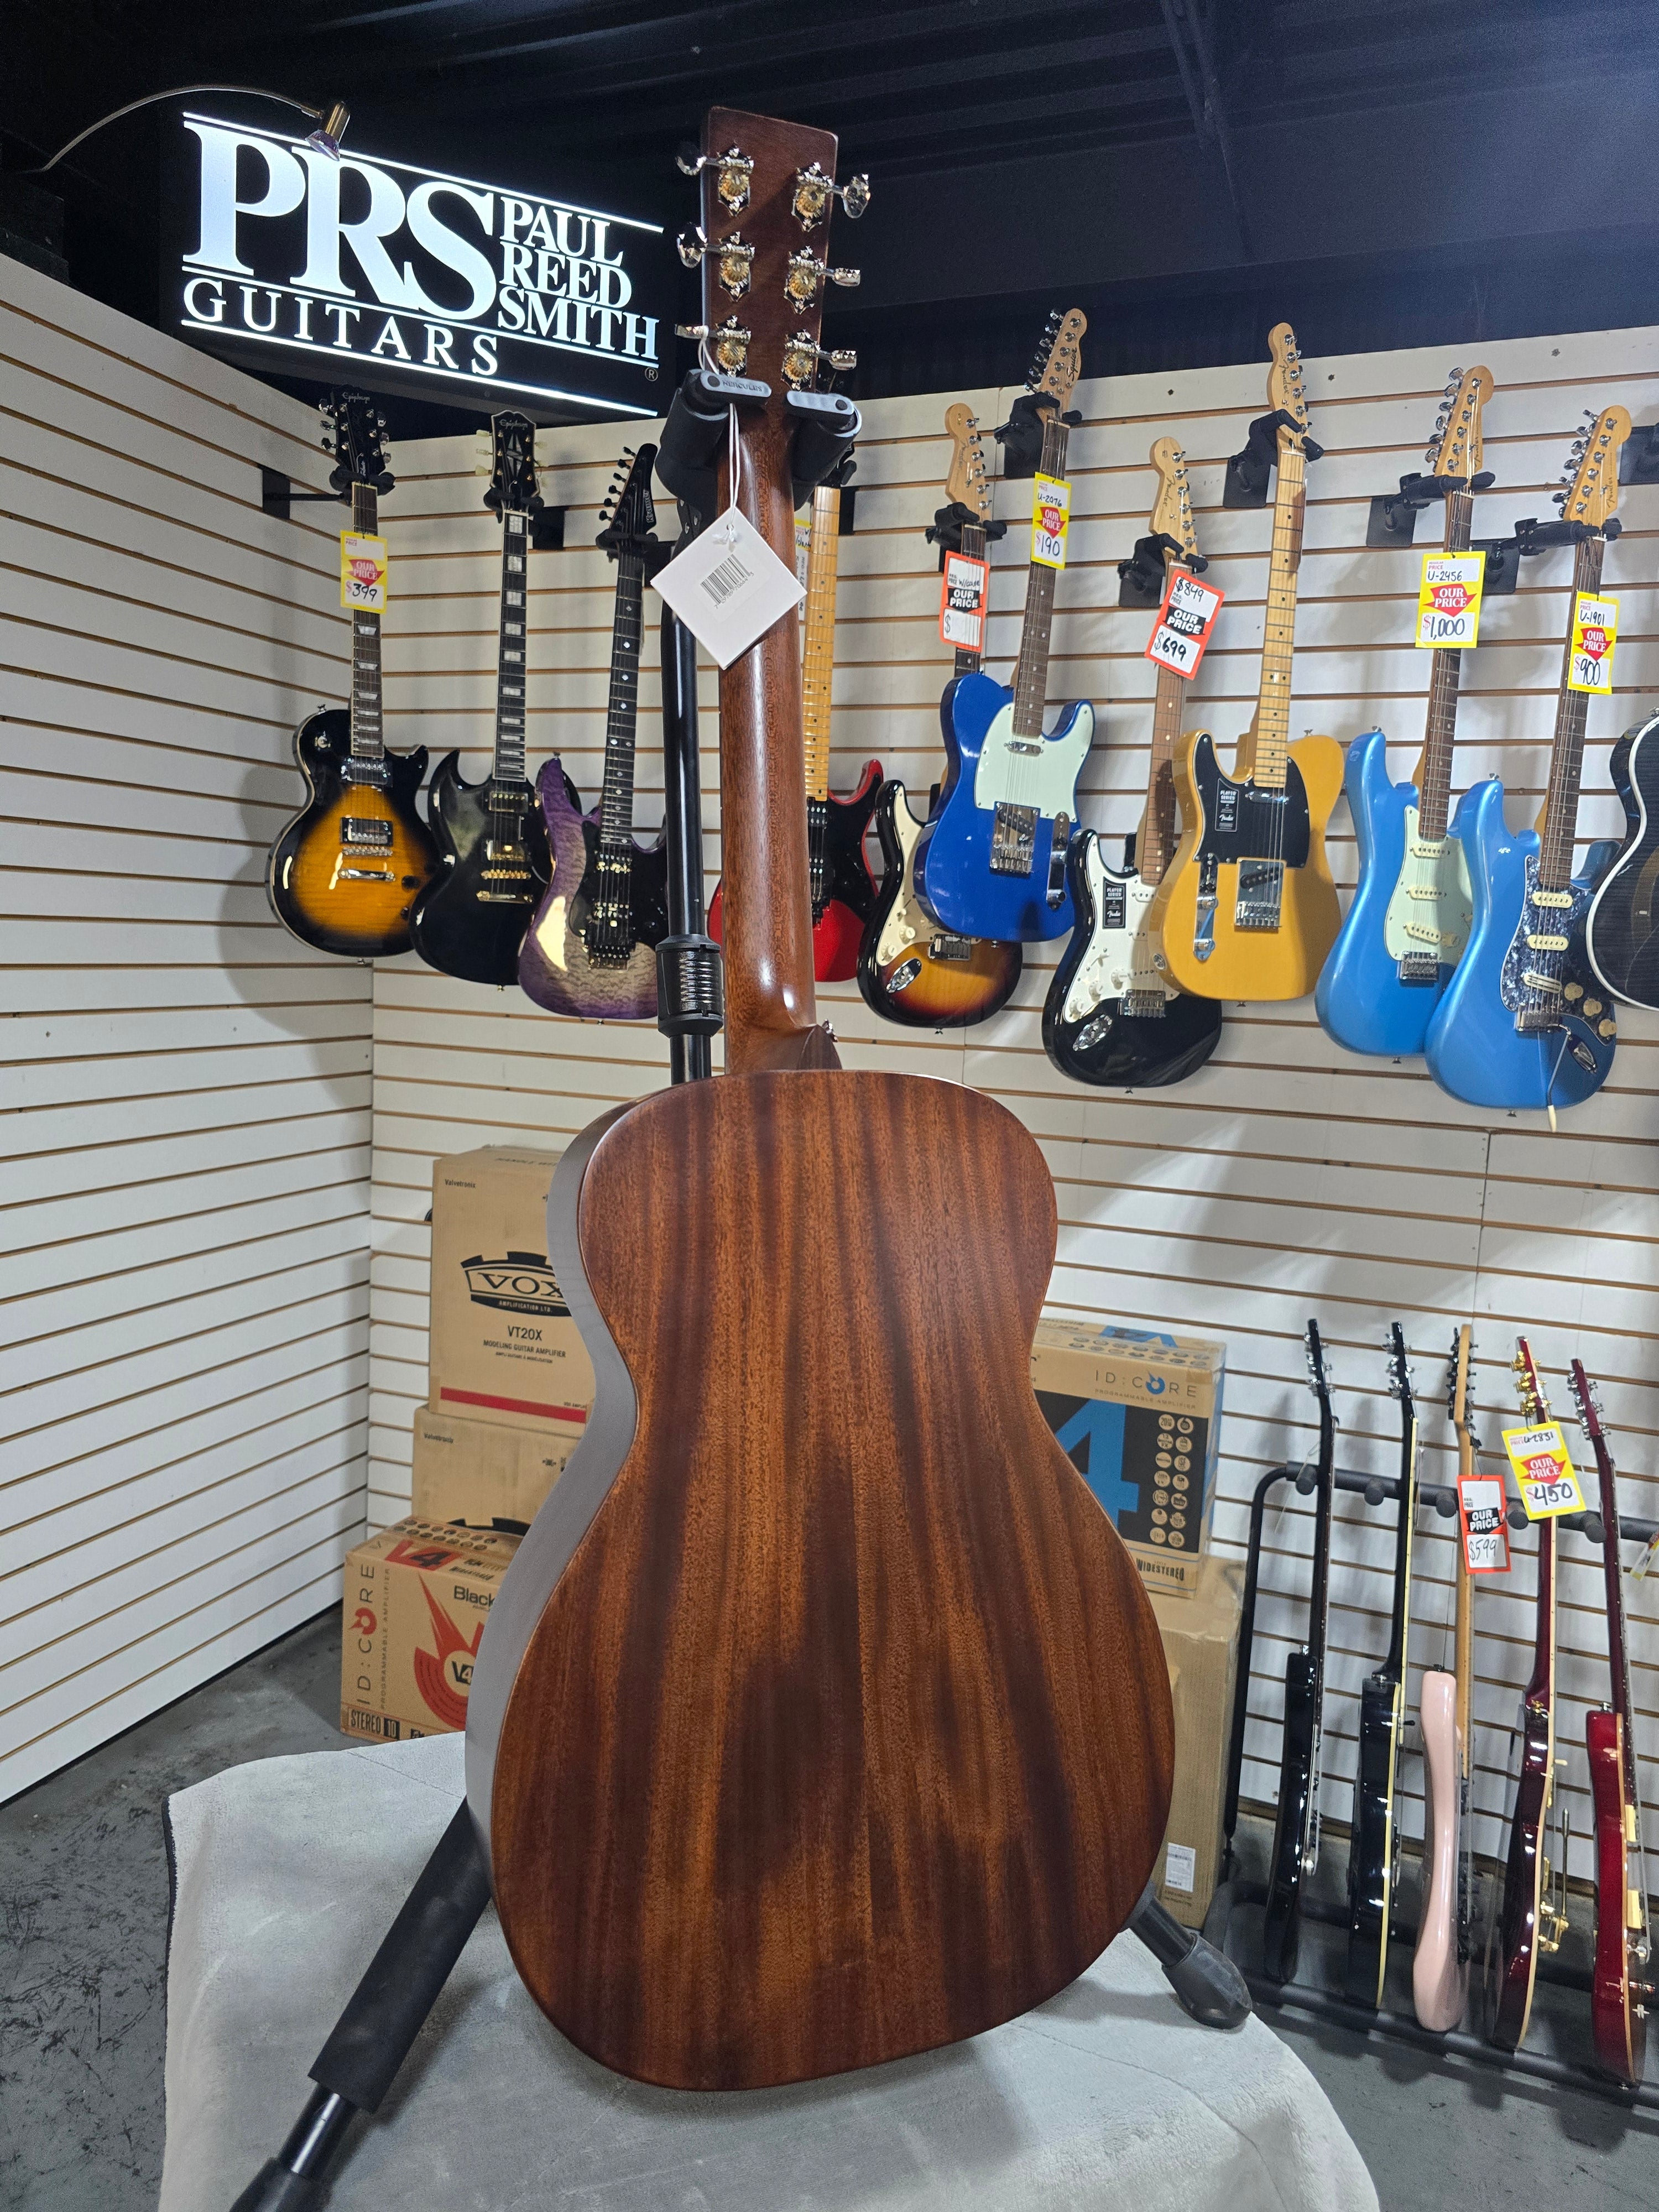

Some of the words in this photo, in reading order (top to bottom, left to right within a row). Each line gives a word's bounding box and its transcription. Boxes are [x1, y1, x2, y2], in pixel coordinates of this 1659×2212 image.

[184, 121, 497, 320] PRS
[499, 196, 624, 267] PAUL
[499, 241, 632, 309] REED
[183, 278, 498, 376] GUITARS
[498, 287, 660, 361] SMITH
[1066, 347, 1078, 382] Squier
[722, 380, 763, 392] HERCULES
[1279, 359, 1291, 394] Fender
[1163, 475, 1175, 507] Fender
[1605, 477, 1615, 508] Fender
[643, 489, 654, 523] Kramer
[1045, 509, 1059, 521] OUR
[1042, 518, 1060, 531] PRICE
[1036, 532, 1060, 556] $190
[353, 570, 378, 580] PRICE
[356, 561, 374, 571] OUR
[1428, 571, 1462, 581] U-2456
[346, 581, 377, 602] $399
[953, 589, 974, 599] OUR
[1176, 578, 1204, 602] $849
[1439, 588, 1464, 598] OUR
[950, 598, 978, 608] PRICE
[1434, 597, 1467, 607] PRICE
[945, 614, 951, 634] $
[1167, 616, 1202, 634] PRICE
[1174, 609, 1199, 624] OUR
[1423, 614, 1465, 640] $1,000
[1587, 630, 1604, 642] OUR
[1154, 632, 1186, 662] $699
[1583, 639, 1606, 652] PRICE
[1574, 656, 1600, 685] $900
[445, 1179, 476, 1188] Valvetronix
[477, 1272, 564, 1298] VOX
[498, 1300, 539, 1311] AMPLIFICATION
[507, 1325, 542, 1340] VT20X
[483, 1339, 512, 1349] MODELING
[513, 1344, 534, 1352] GUITAR
[536, 1348, 566, 1358] AMPLIFIER
[1094, 1388, 1154, 1403] PROGRAMMABLE
[1157, 1399, 1196, 1410] AMPLIFIER
[1529, 1465, 1560, 1479] PRICE
[1530, 1458, 1554, 1469] OUR
[1526, 1483, 1572, 1505] $450
[1469, 1517, 1500, 1531] PRICE
[1472, 1509, 1493, 1521] OUR
[1469, 1539, 1497, 1562] $599
[1136, 1558, 1185, 1581] WIDESTEREO
[351, 1709, 381, 1734] STEREO
[388, 1720, 397, 1738] 10
